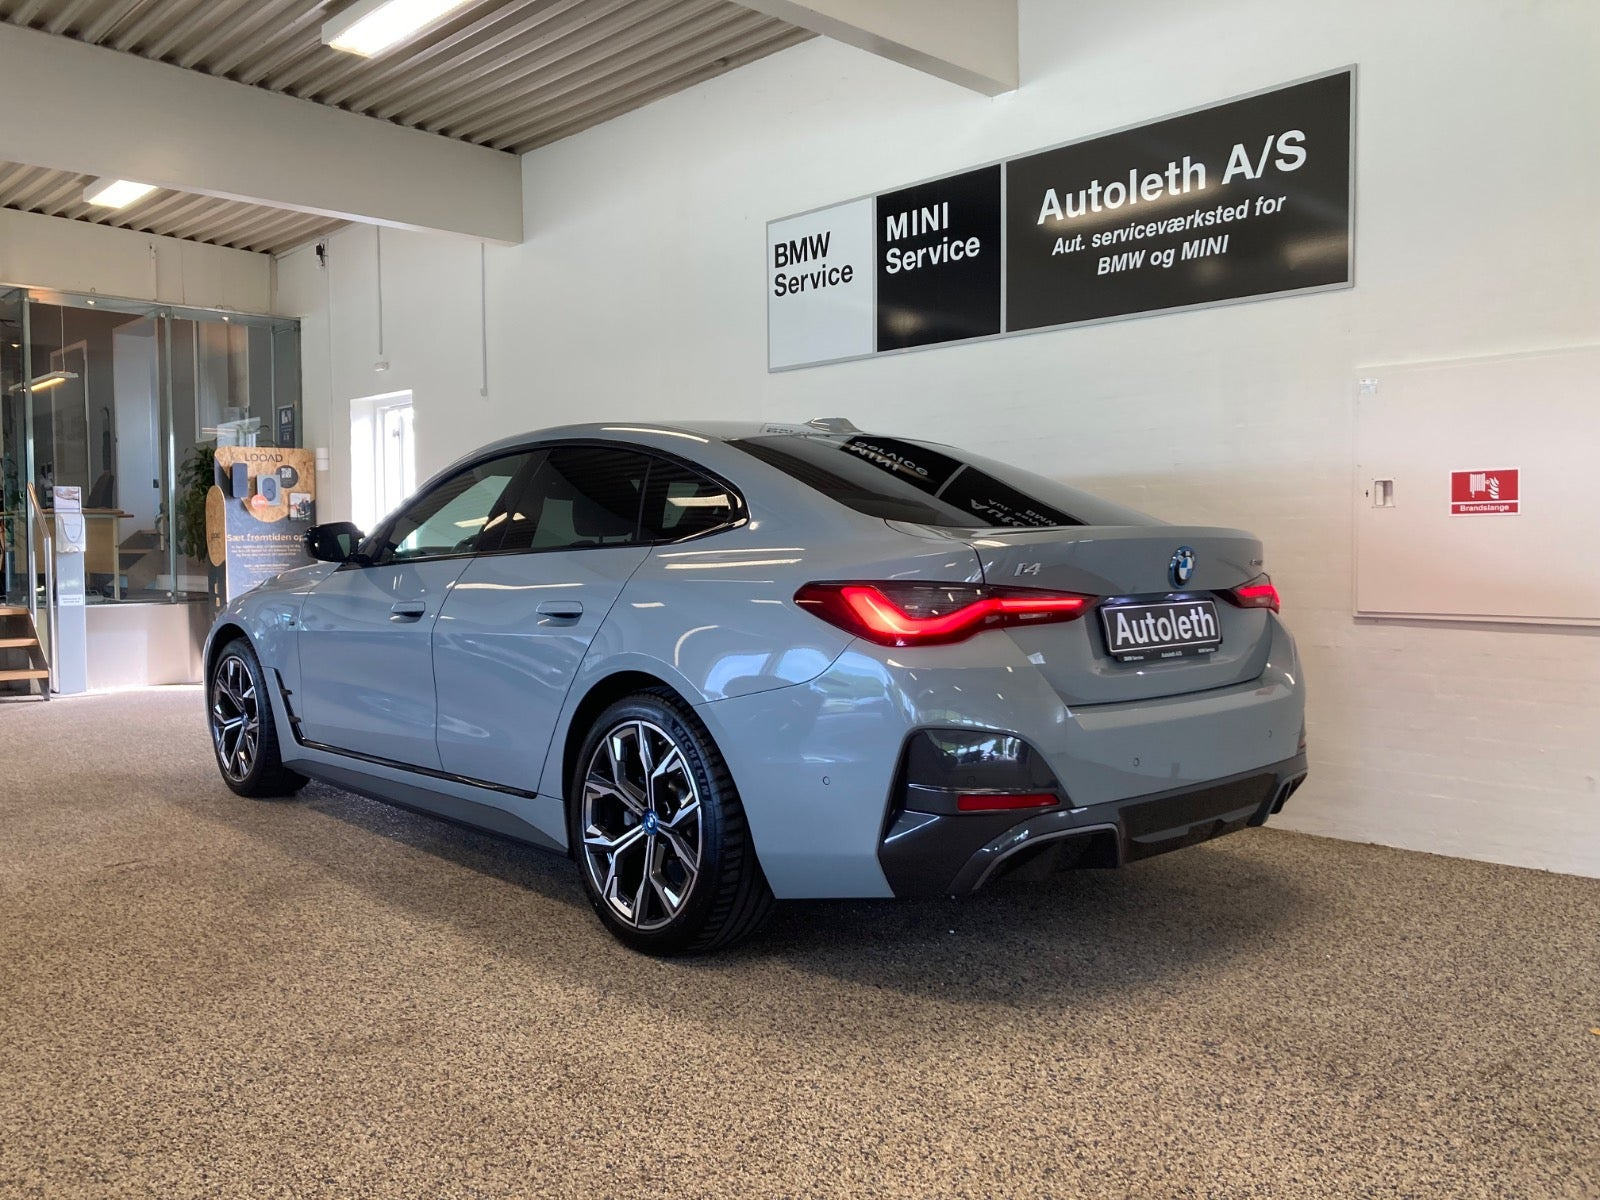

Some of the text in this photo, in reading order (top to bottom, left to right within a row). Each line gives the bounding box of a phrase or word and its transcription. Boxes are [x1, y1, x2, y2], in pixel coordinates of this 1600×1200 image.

[1037, 129, 1307, 225] Autoleth A/S
[886, 202, 948, 242] MINI
[1051, 195, 1287, 256] Aut. serviceværksted for
[774, 231, 830, 268] BMW
[885, 236, 981, 274] Service
[1097, 234, 1230, 276] BMW og MINI
[774, 264, 853, 297] Service
[1460, 504, 1510, 512] Brandslange
[227, 534, 246, 542] Sæt
[1014, 562, 1041, 577] i4
[1116, 606, 1216, 646] Autoleth
[673, 725, 711, 797] MICHELIN
